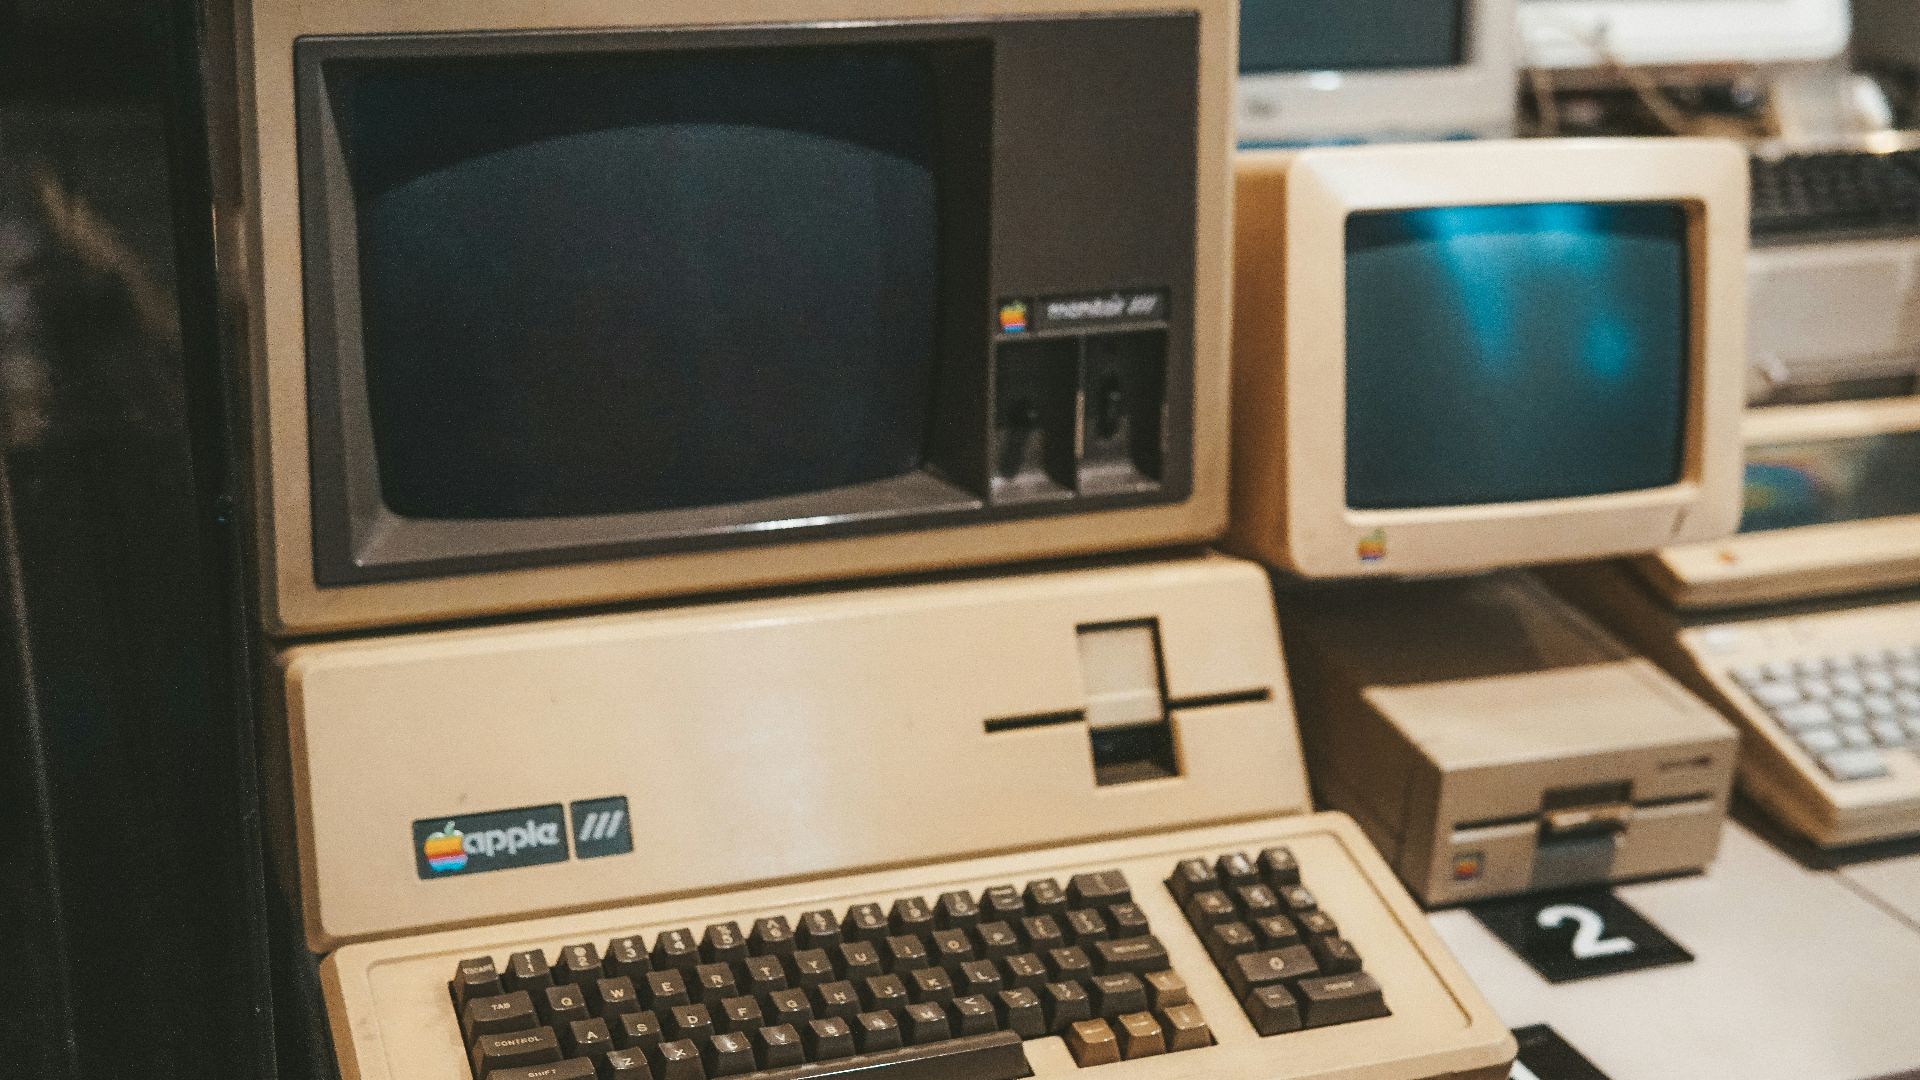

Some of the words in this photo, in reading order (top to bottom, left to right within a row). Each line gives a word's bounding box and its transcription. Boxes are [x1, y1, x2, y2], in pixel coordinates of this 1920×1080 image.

[463, 819, 560, 857] apple
[1536, 903, 1637, 961] 2
[674, 939, 686, 950] 4
[626, 947, 637, 959] 3
[854, 952, 867, 962] U
[810, 959, 822, 969] Y
[710, 974, 724, 986] R
[975, 971, 989, 981] L
[661, 981, 674, 992] E
[926, 977, 940, 987] K
[609, 988, 625, 999] W
[833, 992, 847, 1002] H
[490, 1002, 511, 1011] TAB
[560, 997, 573, 1007] Q
[737, 1007, 747, 1017] F
[687, 1015, 699, 1024] D
[871, 1018, 886, 1028] N
[636, 1023, 648, 1032] S
[586, 1031, 598, 1040] A
[774, 1032, 786, 1042] V
[494, 1036, 542, 1048] CONTROL
[674, 1048, 687, 1057] X
[623, 1057, 635, 1066] Z
[527, 1069, 557, 1078] SHIFT
